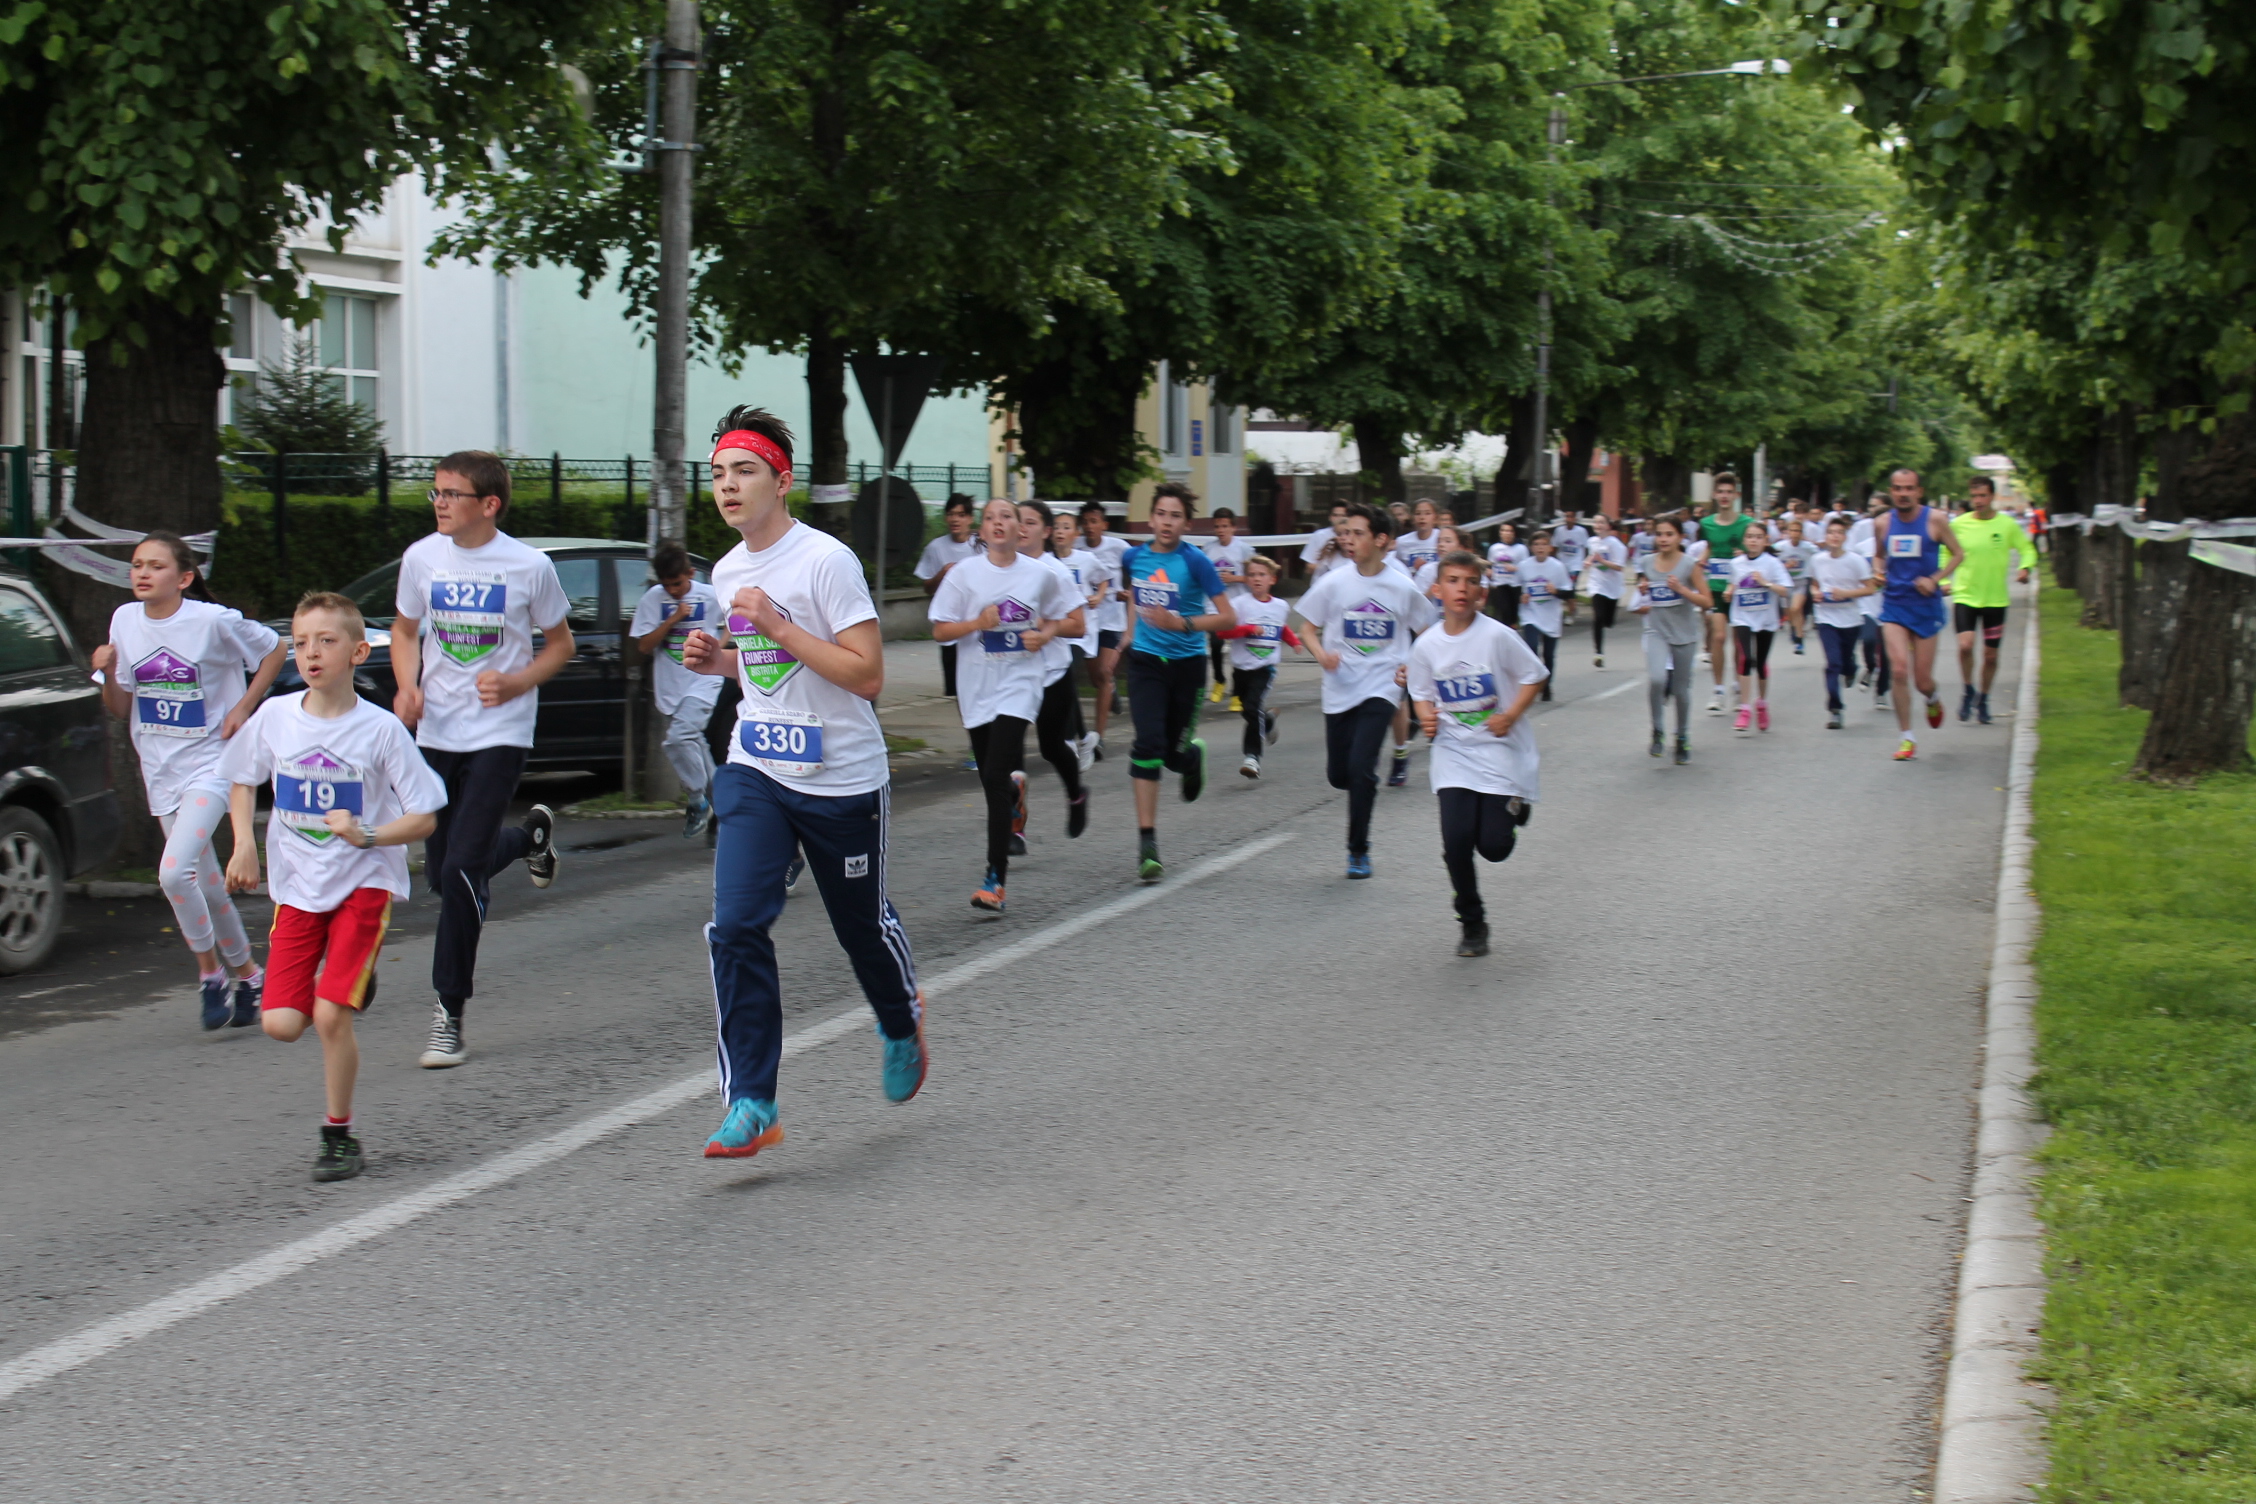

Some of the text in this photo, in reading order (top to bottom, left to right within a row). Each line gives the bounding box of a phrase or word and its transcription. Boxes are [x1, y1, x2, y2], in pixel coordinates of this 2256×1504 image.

[443, 582, 493, 608] 327
[667, 603, 699, 619] 27
[1004, 631, 1019, 649] 9
[1352, 620, 1388, 638] 156
[744, 649, 779, 666] RUNFEST
[1442, 675, 1485, 699] 175
[156, 699, 183, 722] 97
[754, 723, 806, 755] 330
[298, 779, 336, 810] 19
